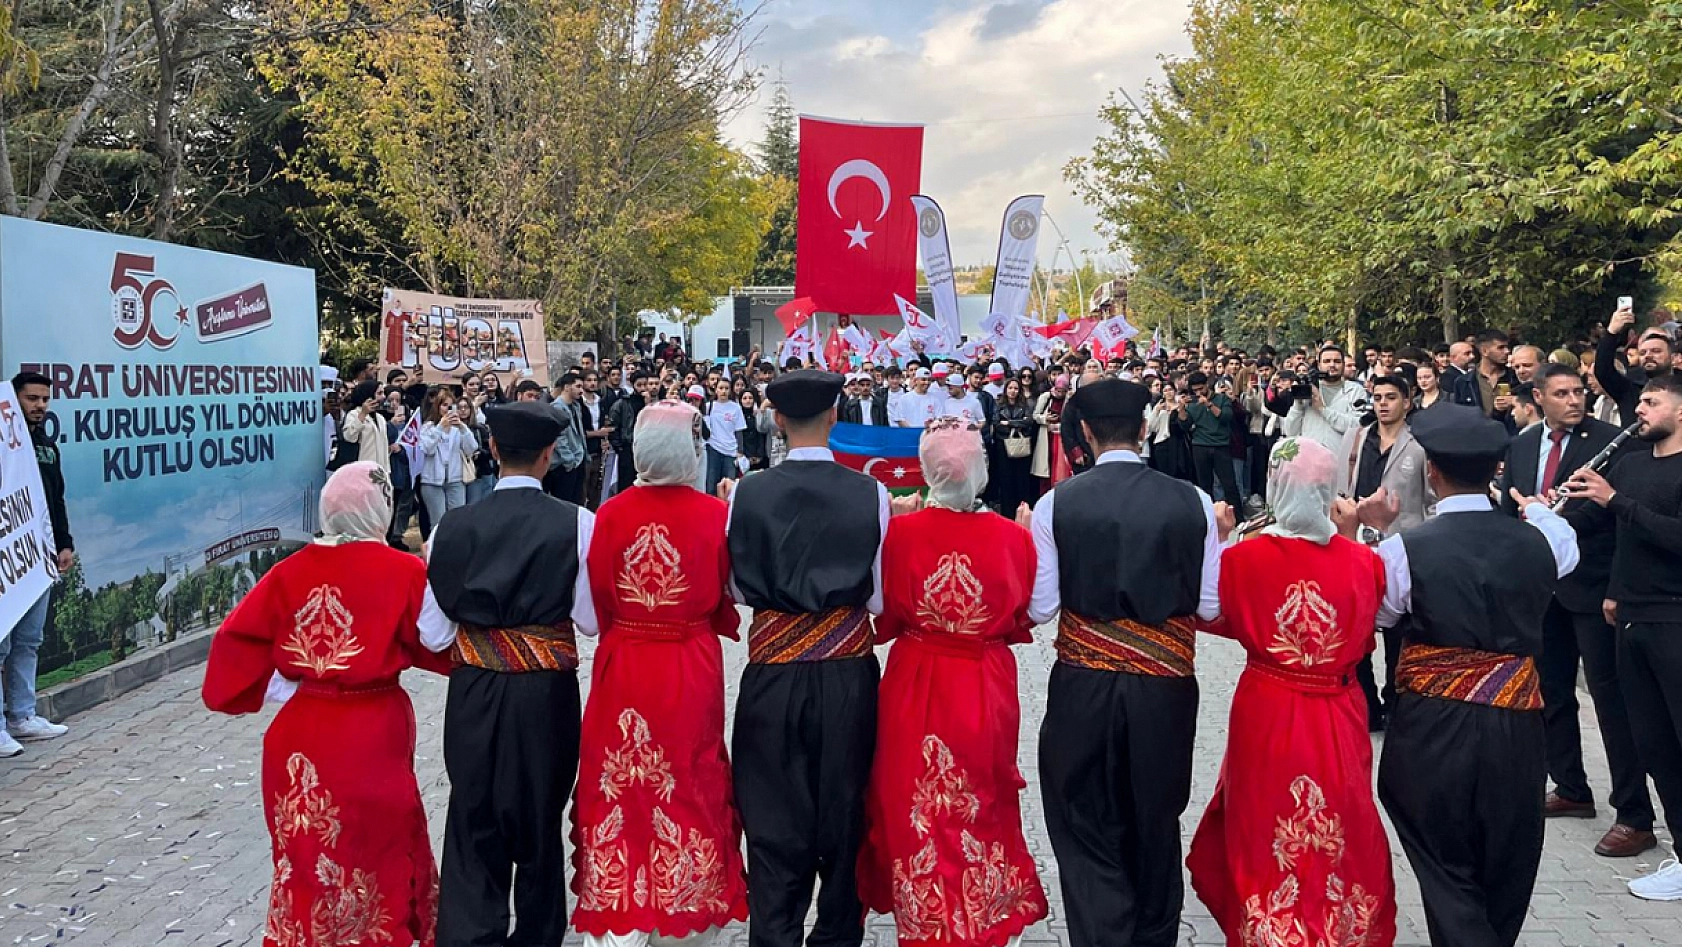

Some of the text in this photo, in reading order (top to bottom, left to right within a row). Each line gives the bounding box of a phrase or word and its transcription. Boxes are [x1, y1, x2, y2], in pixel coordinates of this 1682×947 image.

[122, 364, 316, 397] ÜNİVERSİTESİNİN
[75, 405, 195, 442] KURULUŞ
[200, 403, 234, 432] YIL
[238, 396, 316, 428] DÖNÜMÜ
[103, 440, 193, 483] KUTLU
[199, 433, 274, 469] OLSUN
